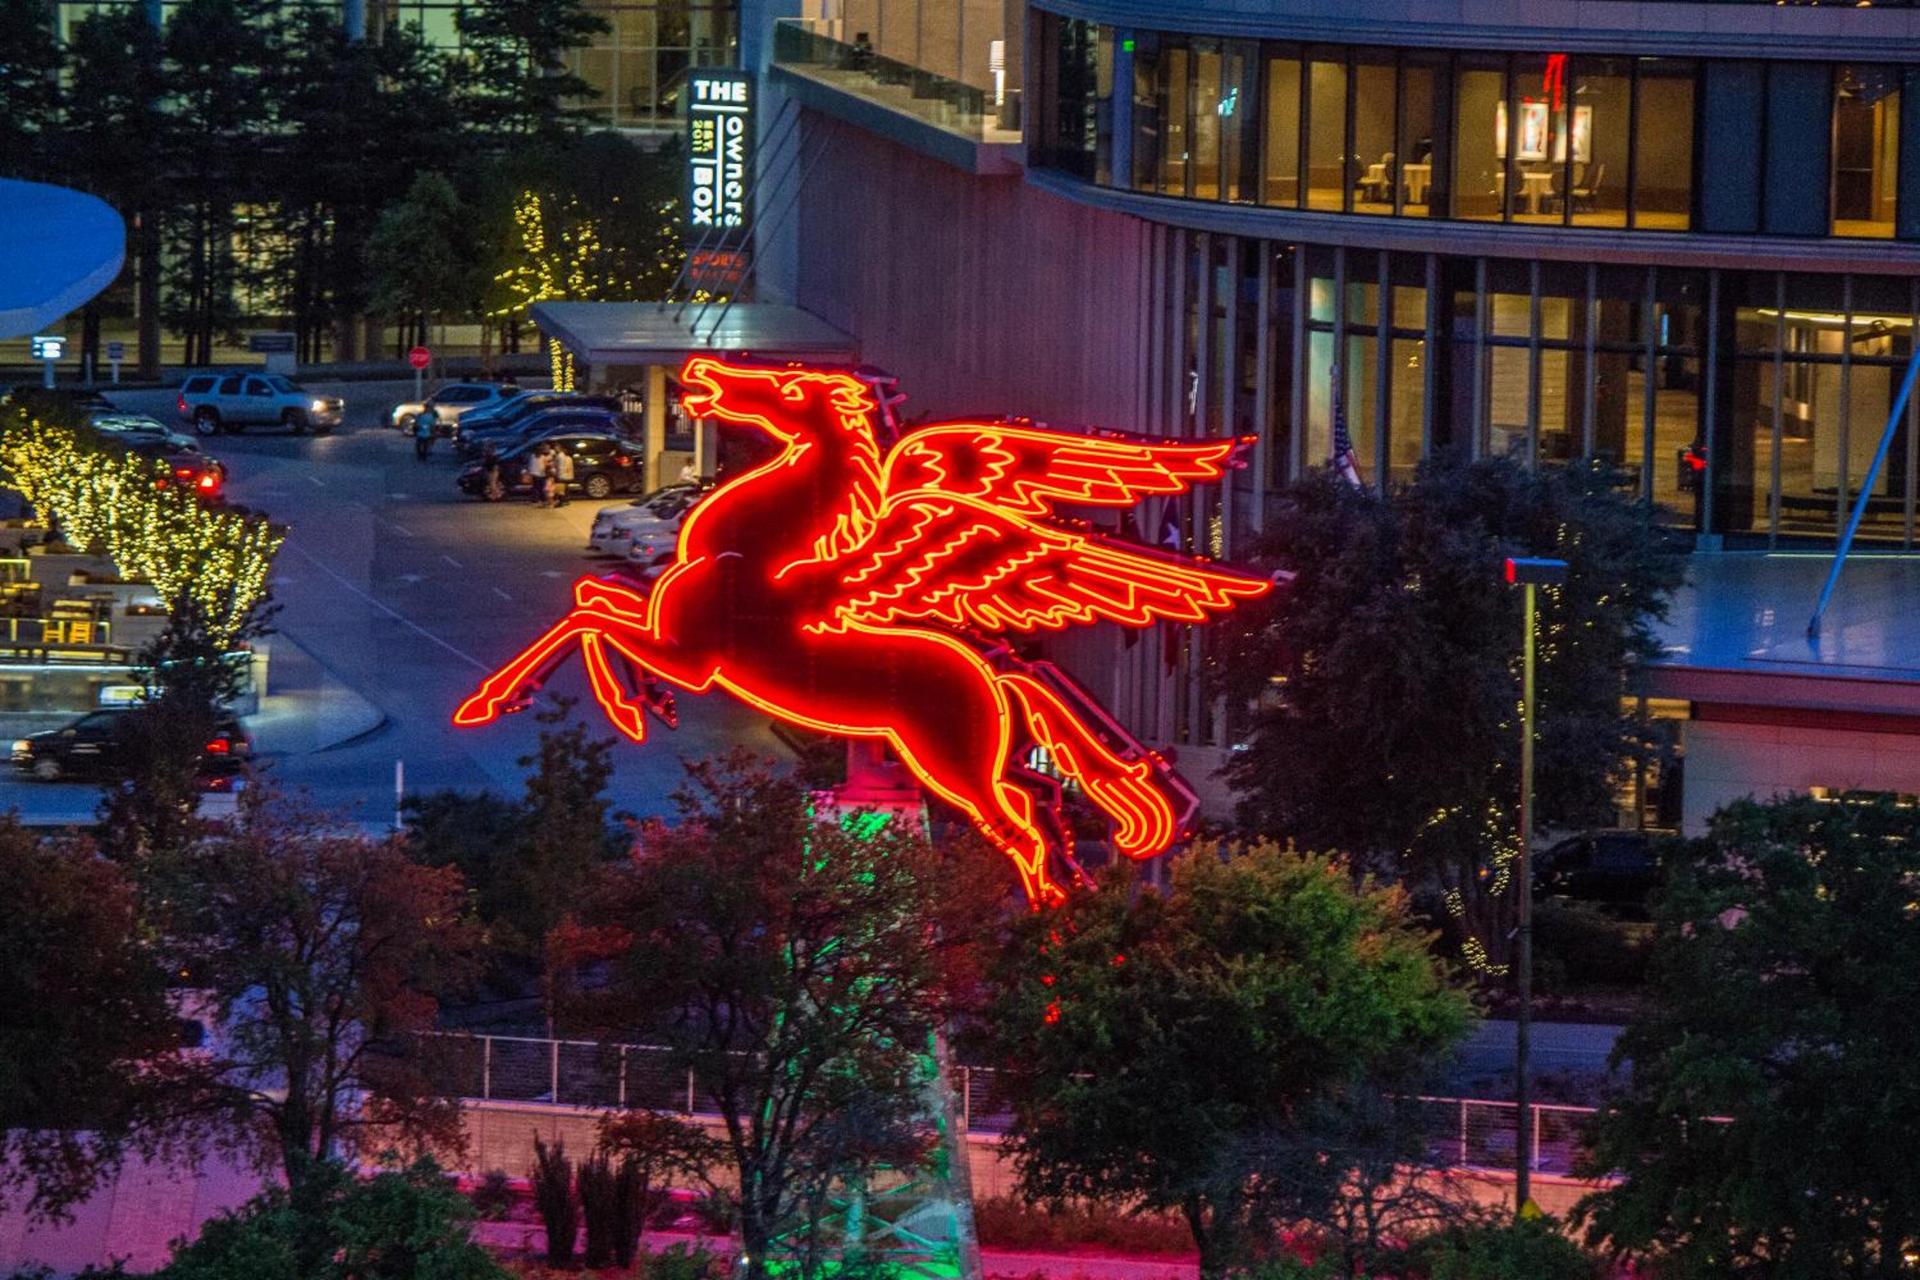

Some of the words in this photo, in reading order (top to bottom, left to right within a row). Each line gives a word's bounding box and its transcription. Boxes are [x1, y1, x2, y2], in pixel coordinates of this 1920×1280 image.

[694, 80, 747, 102] THE
[692, 119, 704, 152] 2011
[692, 166, 714, 227] BOX
